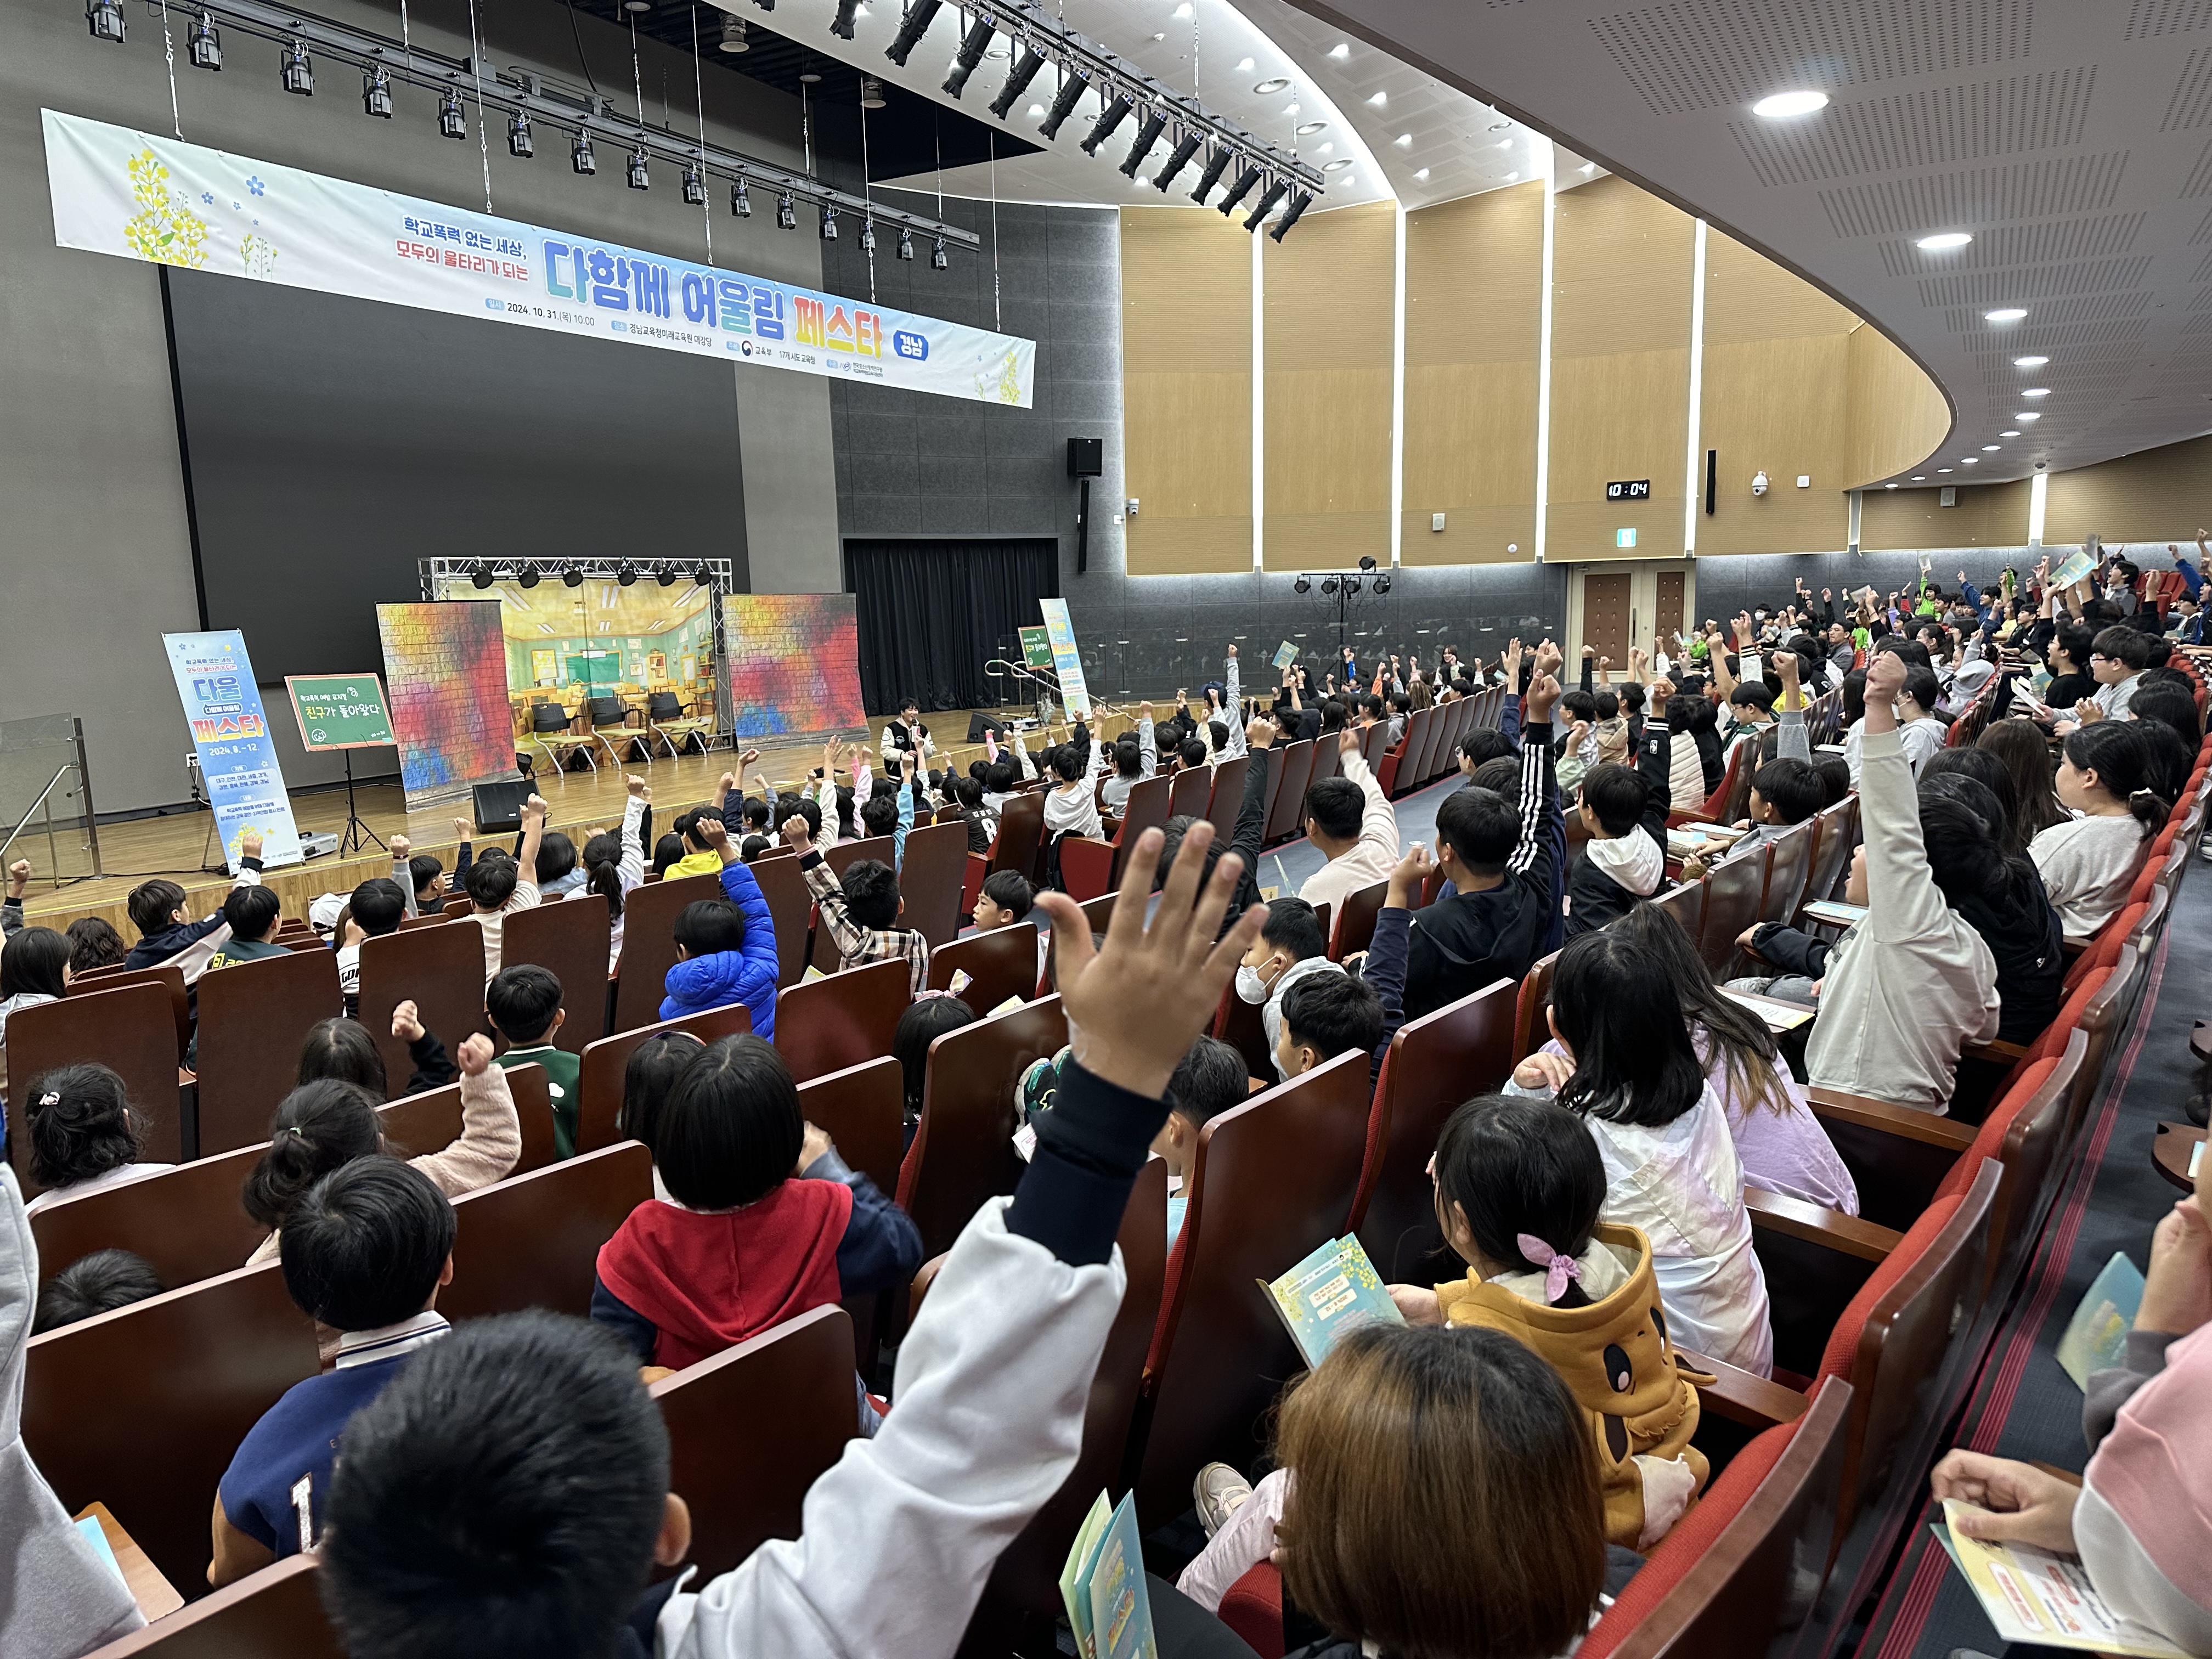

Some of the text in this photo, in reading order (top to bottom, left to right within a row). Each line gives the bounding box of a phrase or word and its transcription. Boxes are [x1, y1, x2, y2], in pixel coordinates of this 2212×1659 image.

[404, 217, 527, 260] 학교폭력 없는 세상,
[397, 240, 528, 281] 모두의 울타리가 되는
[544, 241, 882, 358] 다함께 어울림 페스타
[488, 300, 501, 309] 일시
[507, 303, 531, 315] 2024.
[533, 307, 545, 318] 10.
[574, 314, 595, 326] 10:00
[630, 324, 693, 343] 경남교육청미래교육원
[694, 335, 712, 347] 대강당
[900, 334, 923, 357] 경남
[755, 346, 772, 356] 교육부
[1609, 483, 1647, 496] 10:04
[193, 677, 242, 701] 다울
[305, 703, 380, 719] 친구가 돌아왔다
[193, 714, 264, 743] 페스타
[981, 817, 997, 844] 8
